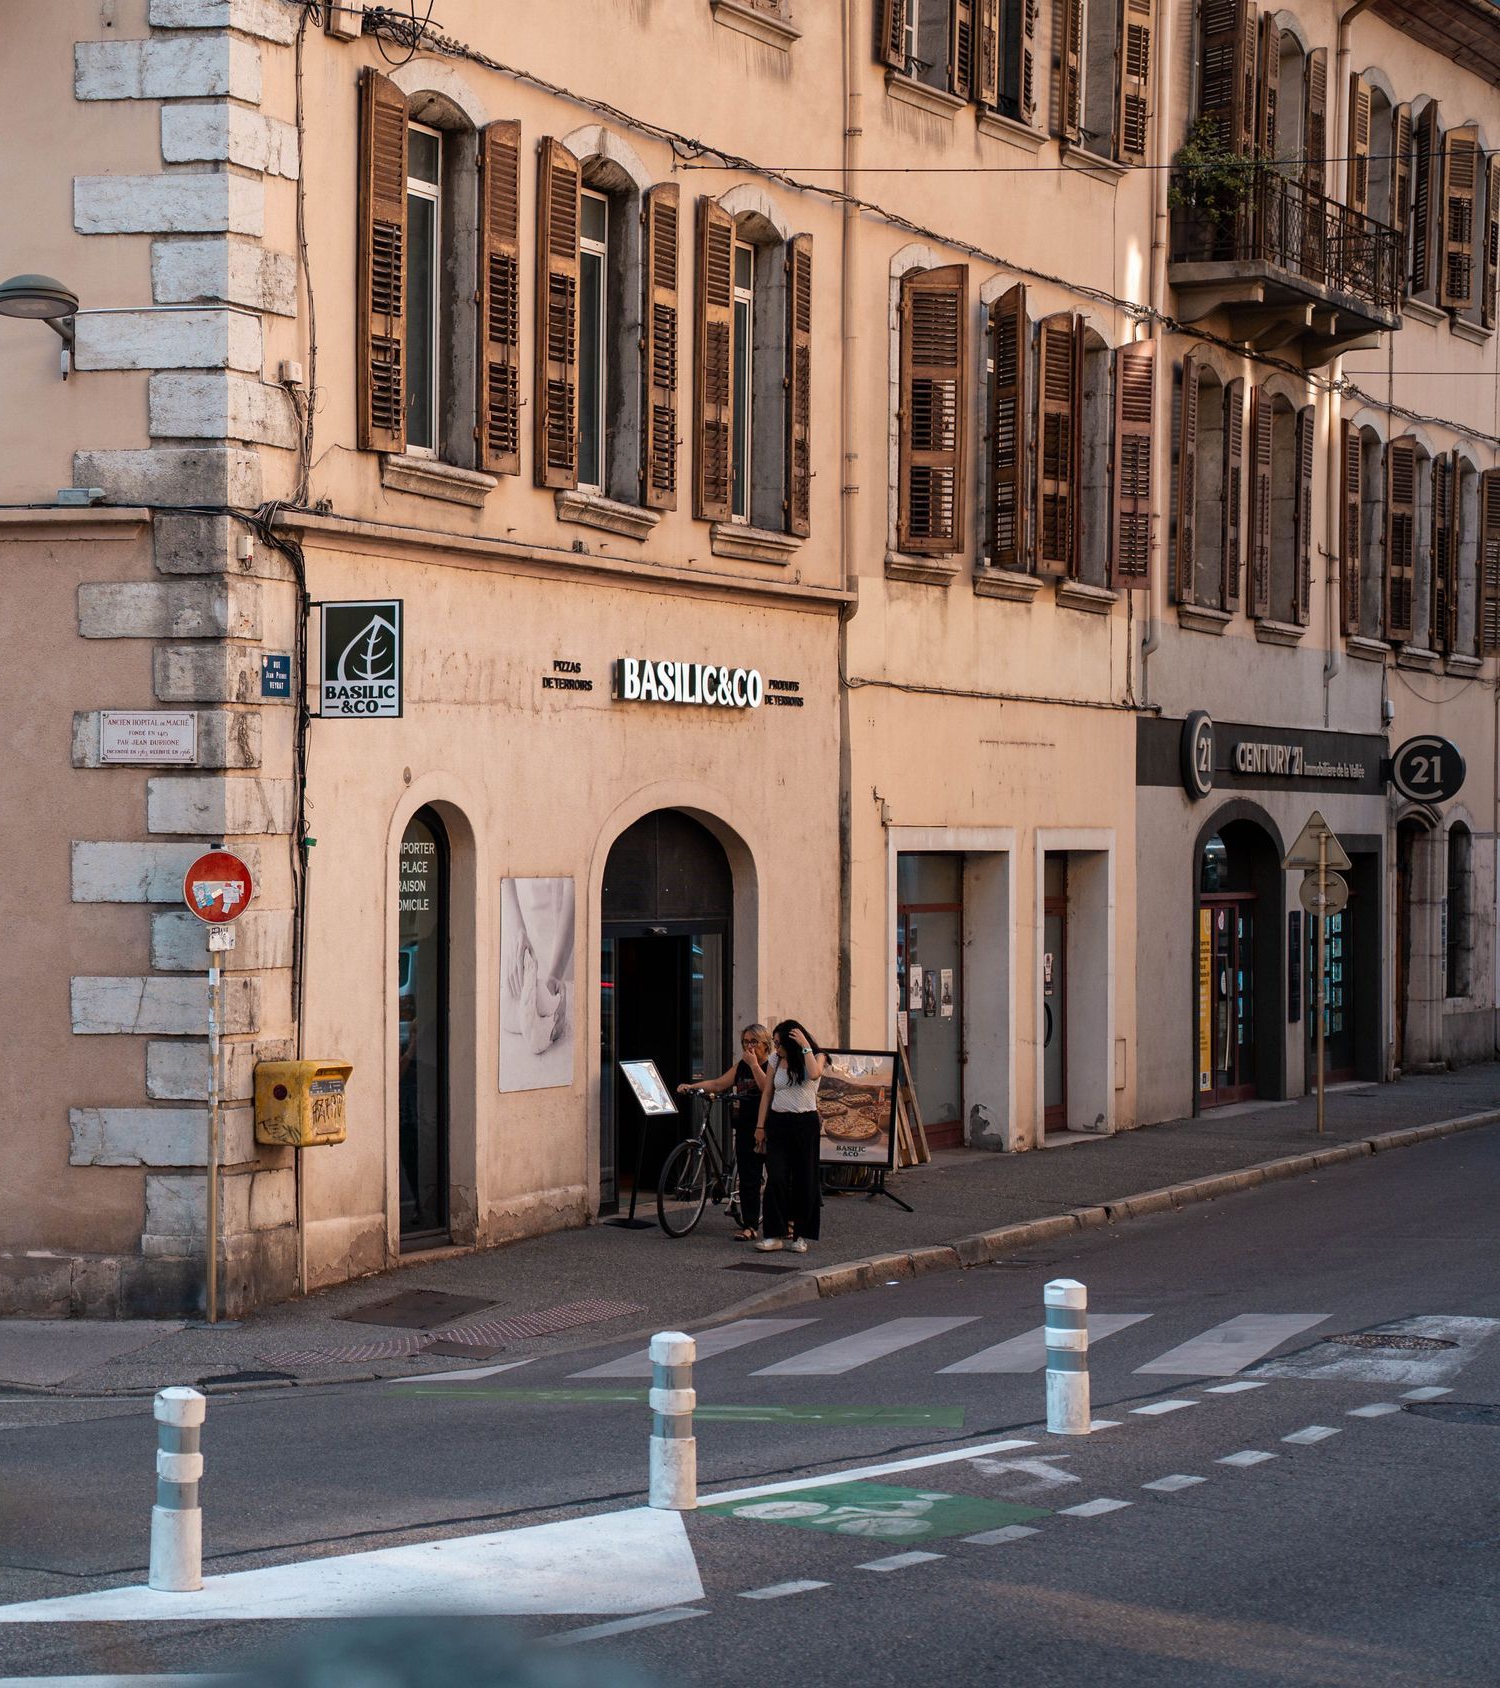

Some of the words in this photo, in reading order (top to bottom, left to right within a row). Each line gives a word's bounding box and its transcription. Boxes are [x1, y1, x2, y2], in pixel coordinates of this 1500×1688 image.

[553, 660, 582, 674] PIZZAS
[542, 677, 554, 689] DE
[553, 678, 593, 691] TERROIRS
[623, 657, 763, 708] BASILIC&CO
[768, 679, 800, 691] PRODUITS
[325, 685, 395, 700] BASILIC
[341, 700, 379, 713] &CO
[1236, 742, 1291, 774] CENTURY
[1291, 746, 1303, 775] 21
[1410, 756, 1442, 784] 21
[401, 861, 428, 873] PLACE
